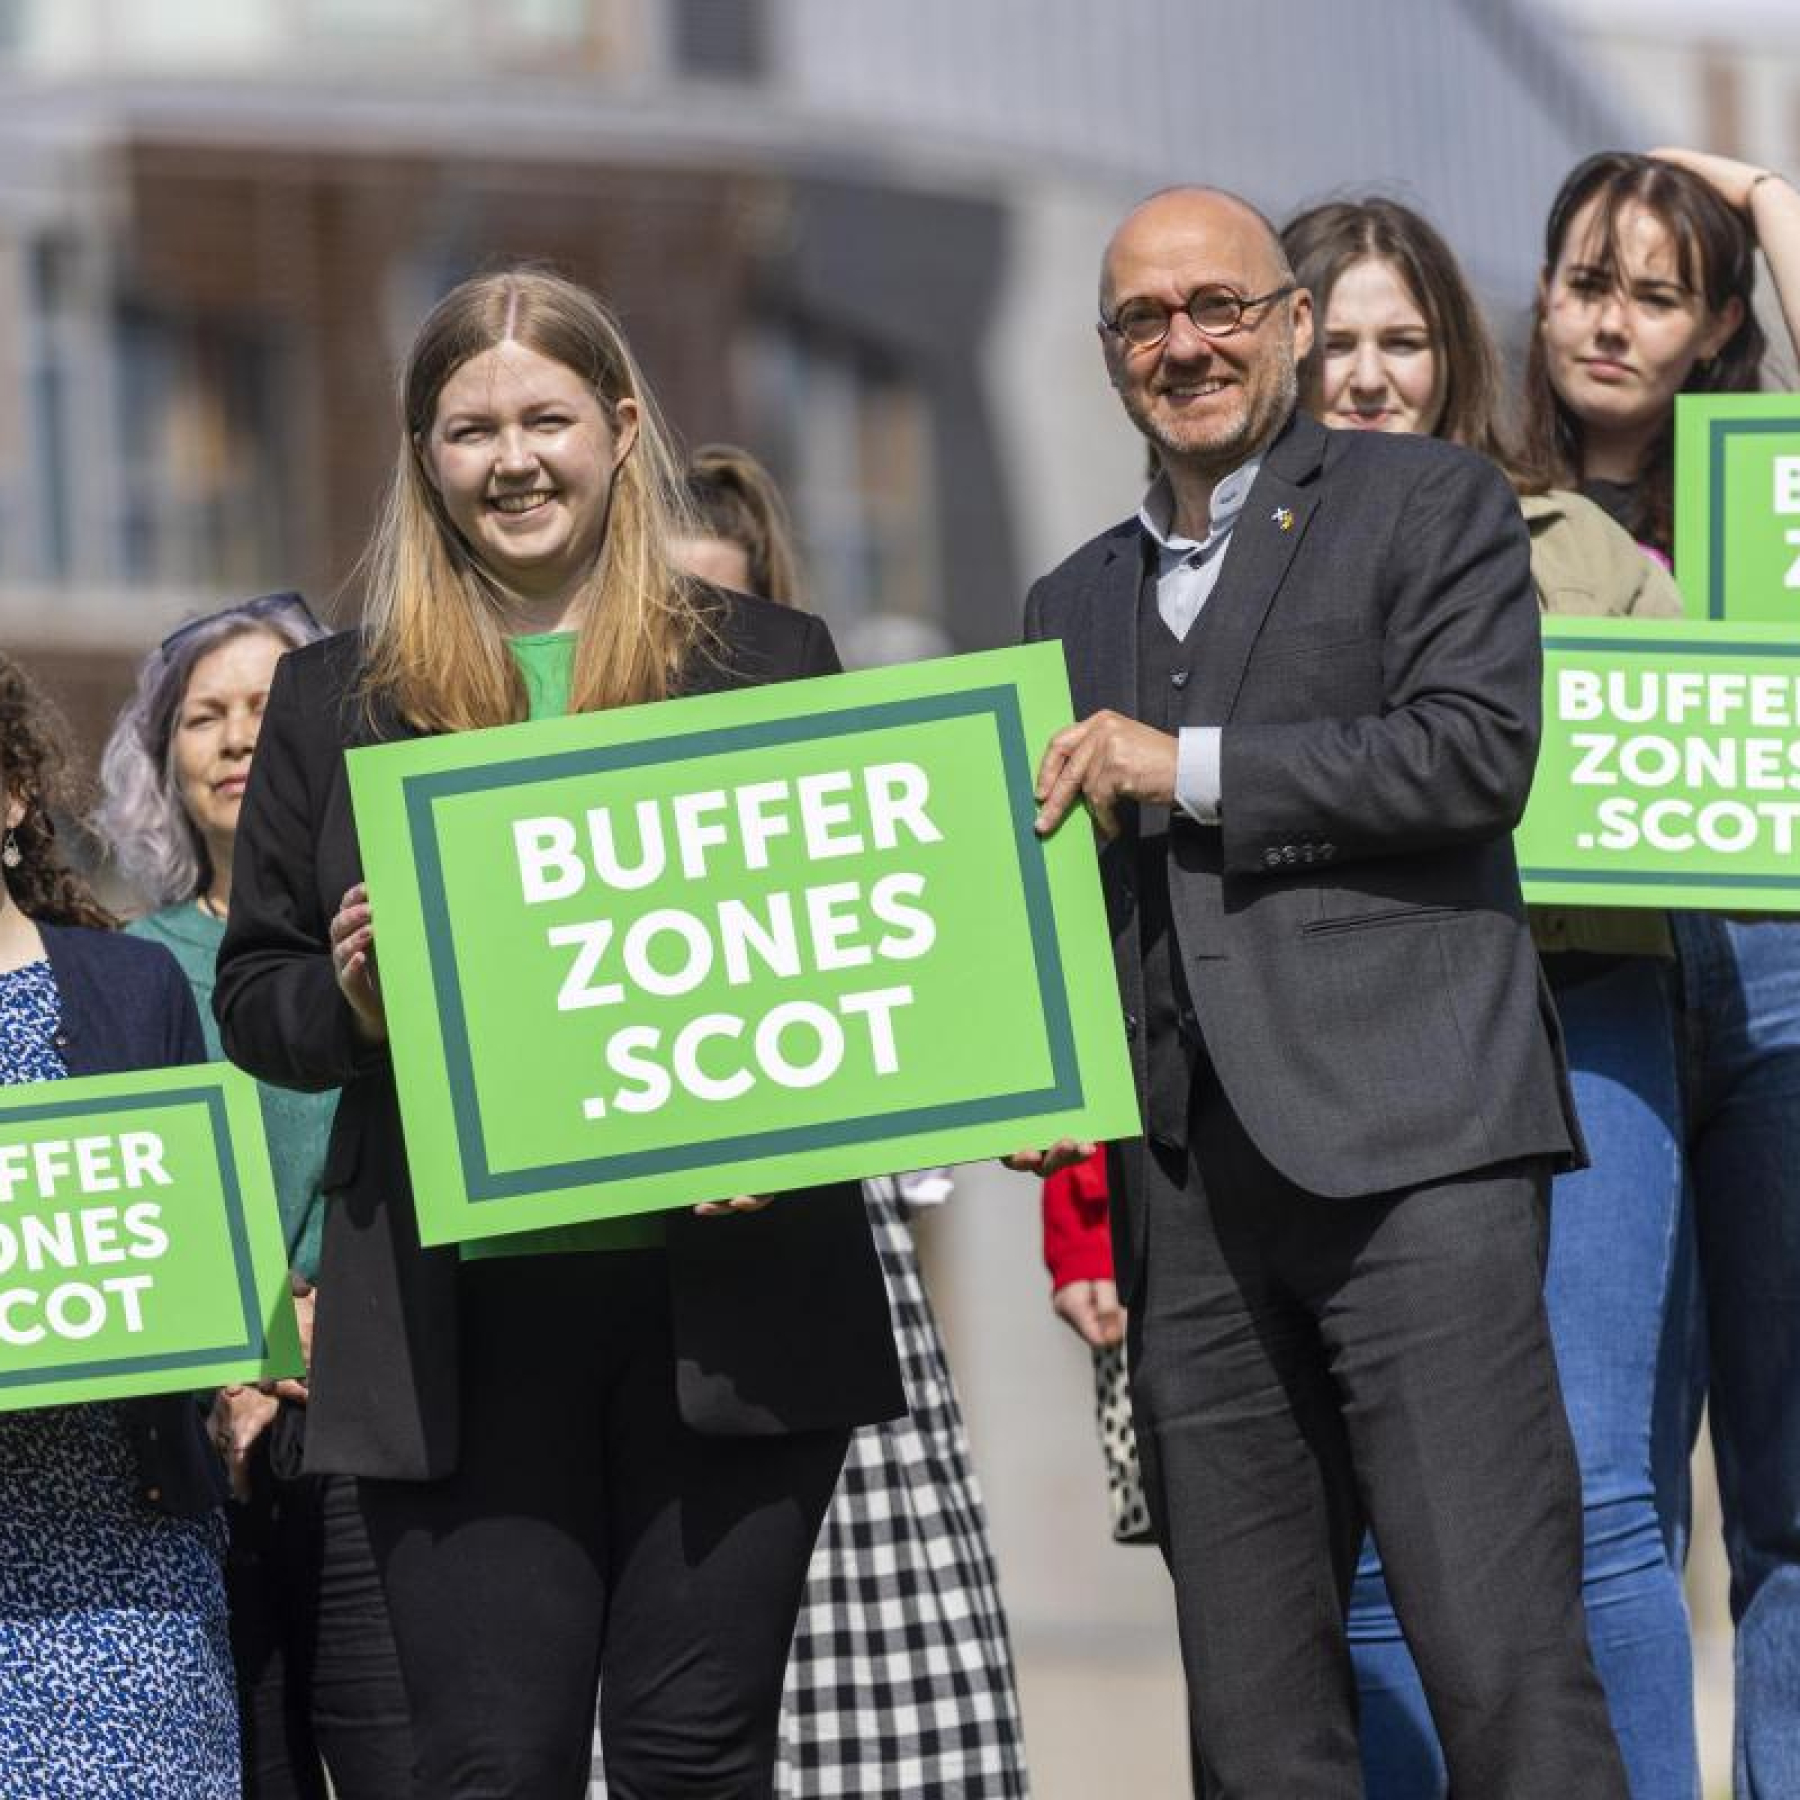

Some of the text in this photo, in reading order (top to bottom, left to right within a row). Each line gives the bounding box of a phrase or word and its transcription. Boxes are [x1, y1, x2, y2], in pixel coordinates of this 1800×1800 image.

[1558, 669, 1800, 728] BUFFE
[512, 762, 943, 904] BUFFER
[1576, 796, 1800, 854] .SCOT
[548, 872, 937, 1011] ZONES
[582, 985, 914, 1119] .SCOT
